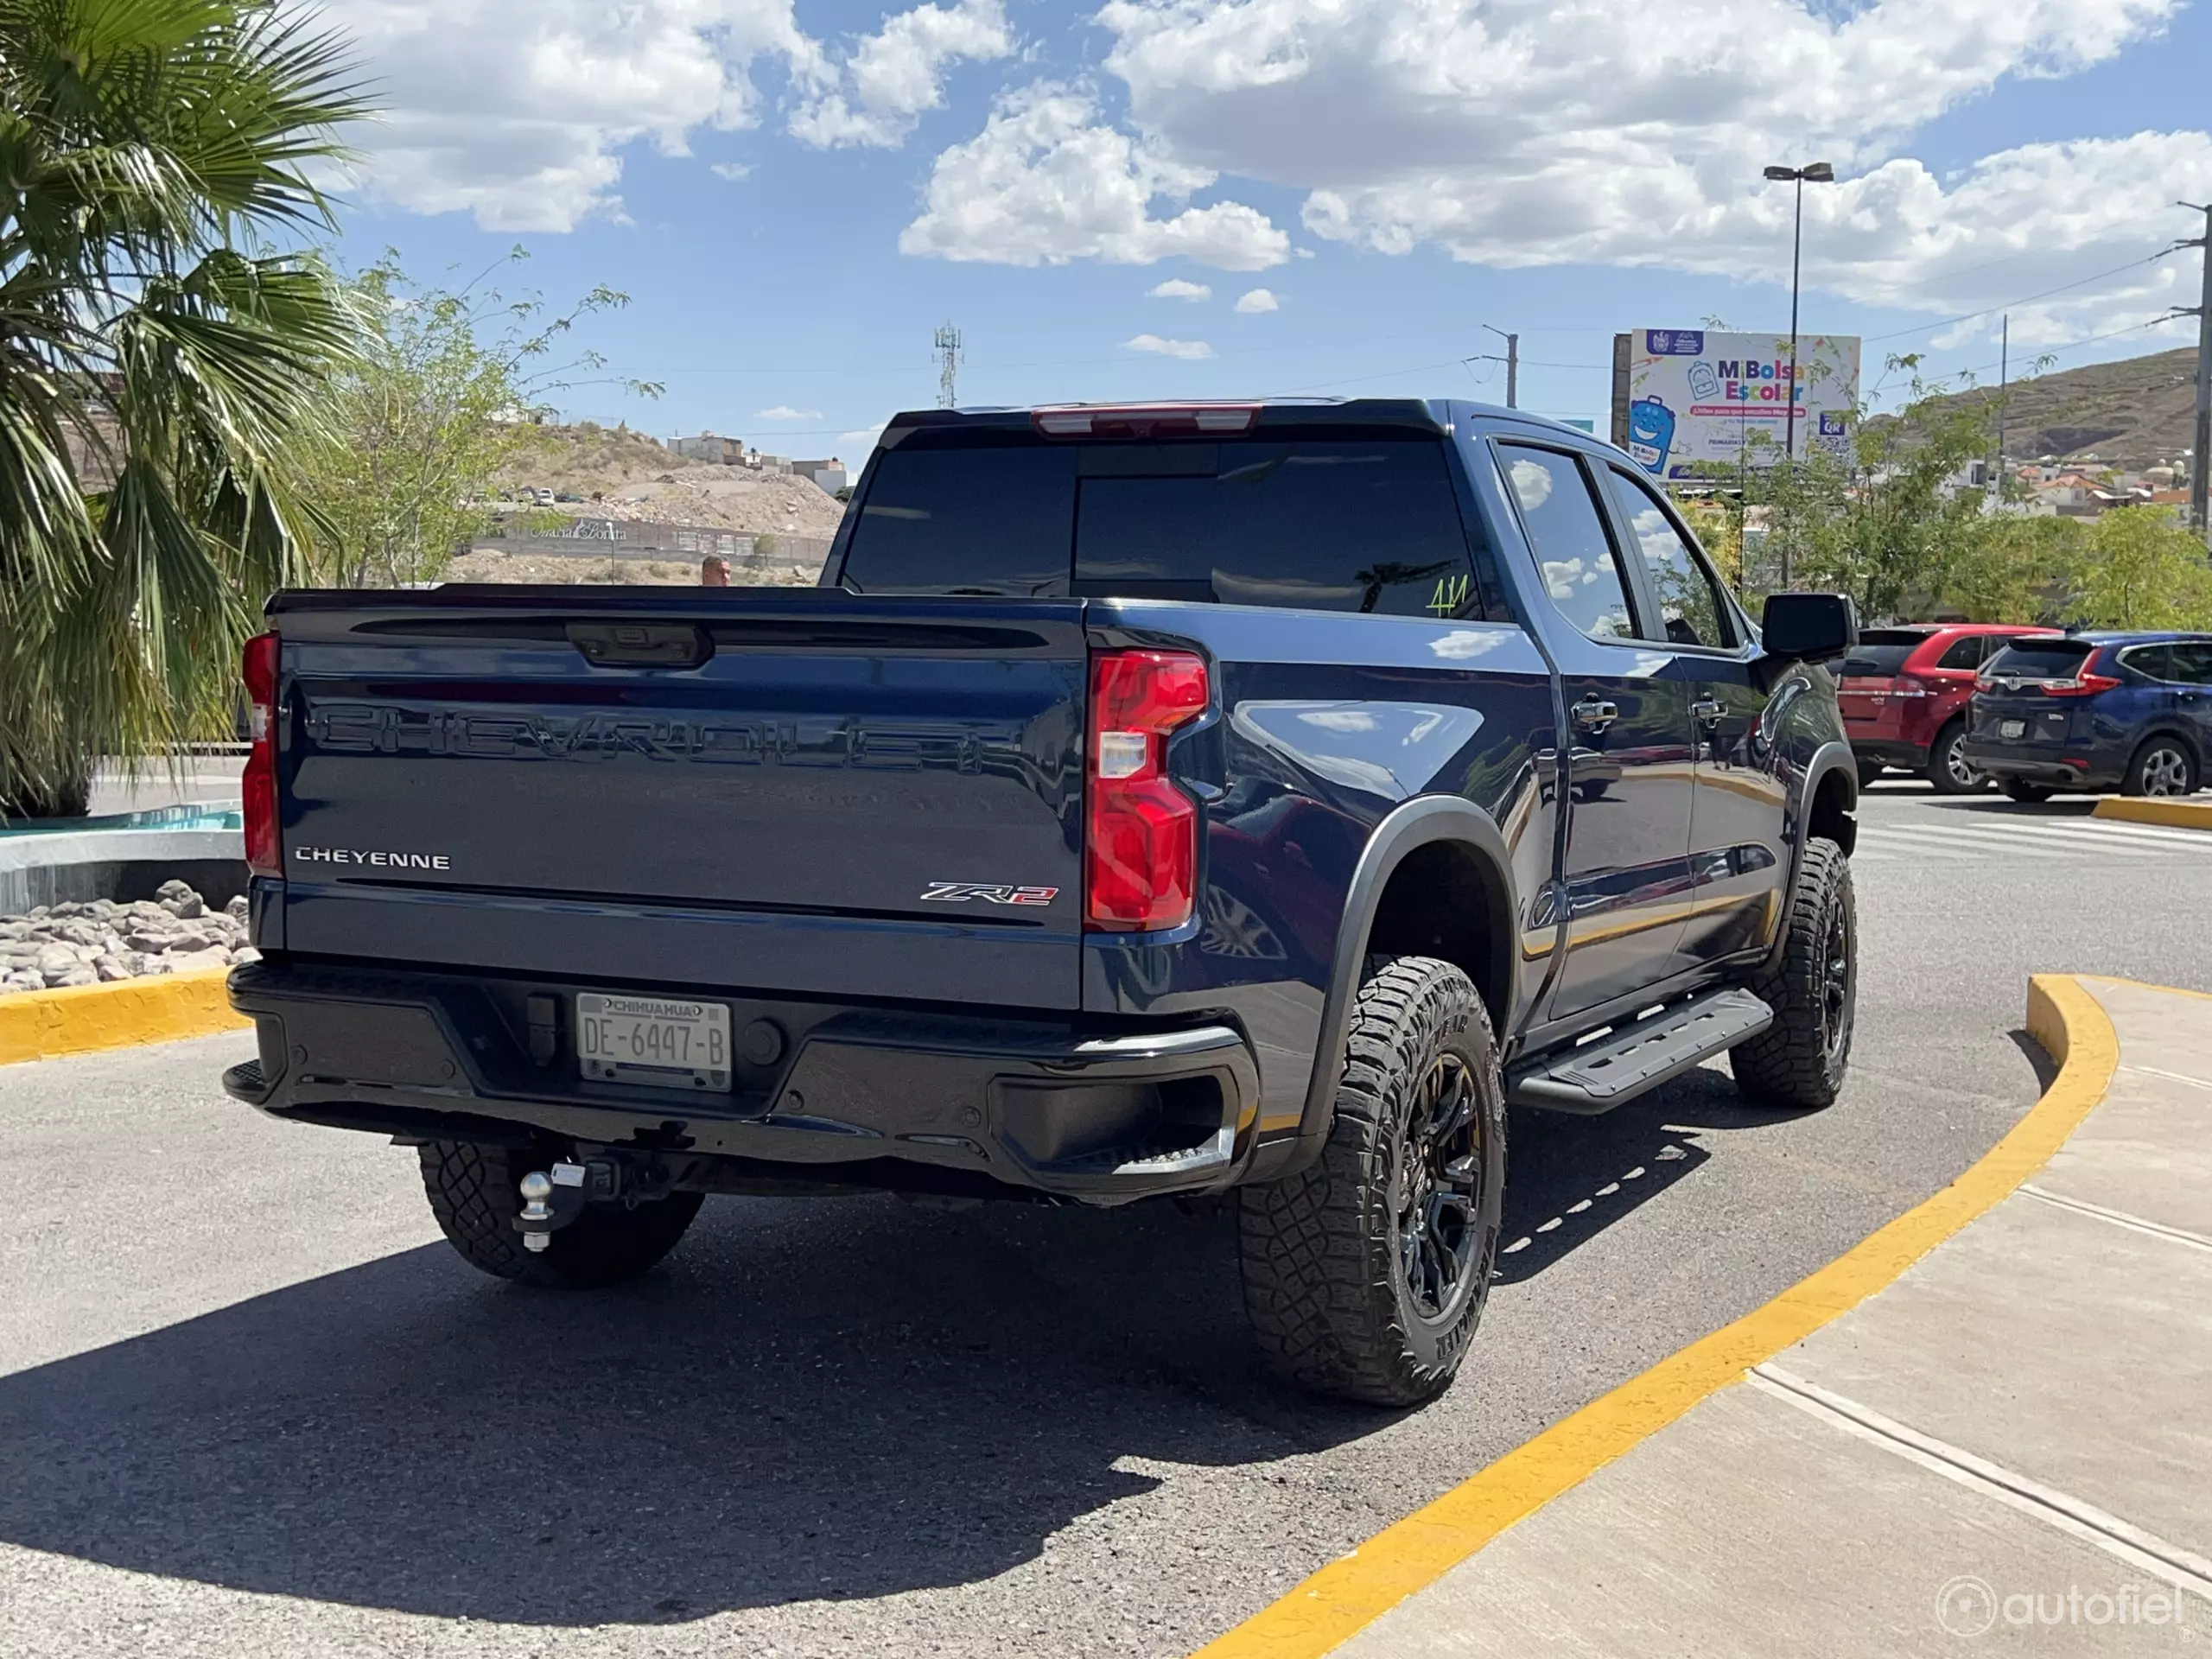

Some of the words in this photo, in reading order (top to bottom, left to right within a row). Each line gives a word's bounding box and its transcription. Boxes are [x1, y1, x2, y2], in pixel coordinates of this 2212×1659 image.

[1746, 359, 1804, 379] Bolsa
[1726, 381, 1803, 401] Escolar
[1824, 422, 1840, 434] QR
[578, 521, 626, 540] Bonta
[316, 703, 1020, 774] CHEVROLET
[296, 846, 450, 870] CHEYENNE
[920, 881, 1059, 906] ZR2
[613, 1000, 691, 1017] CHIHUAHUA
[584, 1017, 724, 1065] DE-6447-B
